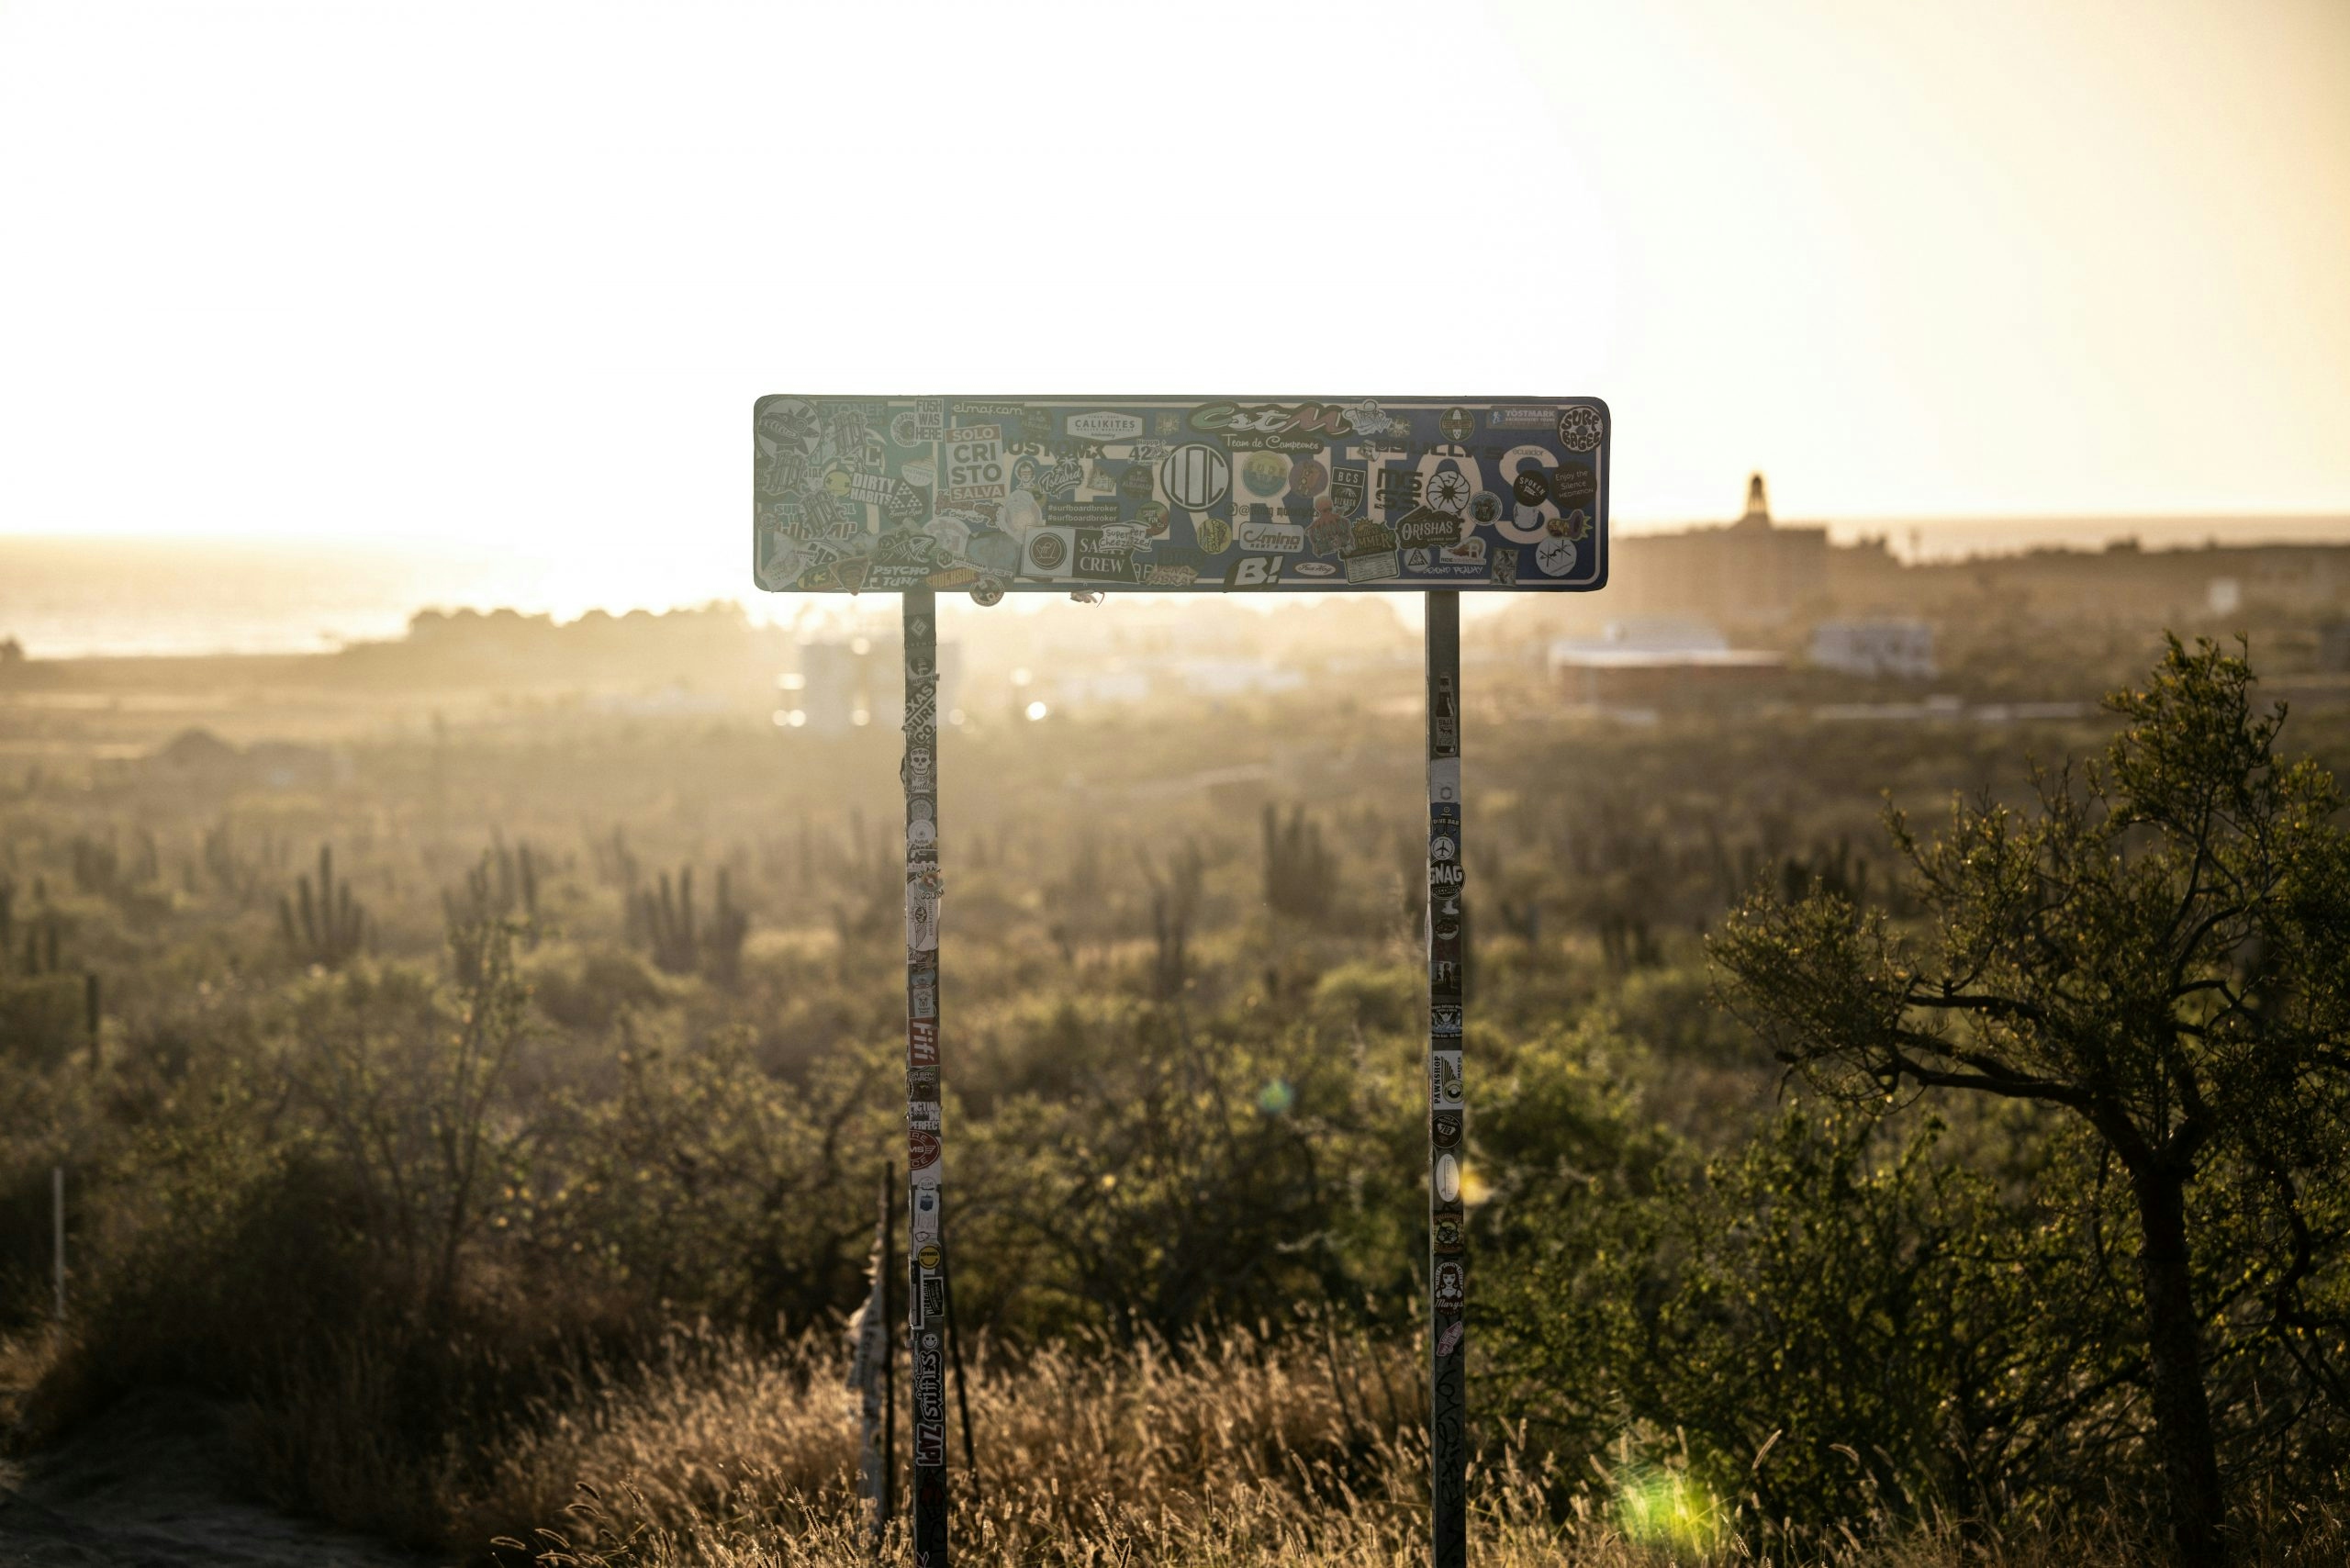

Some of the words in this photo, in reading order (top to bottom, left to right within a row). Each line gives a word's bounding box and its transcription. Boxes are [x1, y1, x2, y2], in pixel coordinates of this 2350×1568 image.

[919, 414, 940, 426] WAS
[1075, 420, 1136, 429] CALIKITES
[1561, 409, 1600, 431] SURF
[916, 427, 942, 441] HERE
[953, 427, 994, 442] SOLO
[1221, 433, 1250, 448] Team
[1252, 438, 1263, 448] de
[1265, 435, 1319, 451] Campeones
[954, 442, 996, 464] CRI
[853, 473, 896, 491] DIRTY
[951, 464, 1002, 485] STO
[1337, 474, 1357, 484] BCS
[1555, 473, 1574, 482] Enjoy
[1577, 470, 1589, 478] the
[850, 488, 892, 504] HABITS
[954, 486, 1003, 501] SALVA
[1047, 504, 1118, 512] #surfboardbroker
[1047, 514, 1117, 522] #surfboardbroker
[1402, 521, 1454, 541] ORISHAS
[873, 566, 930, 576] PSYCHO
[1080, 558, 1125, 574] CREW
